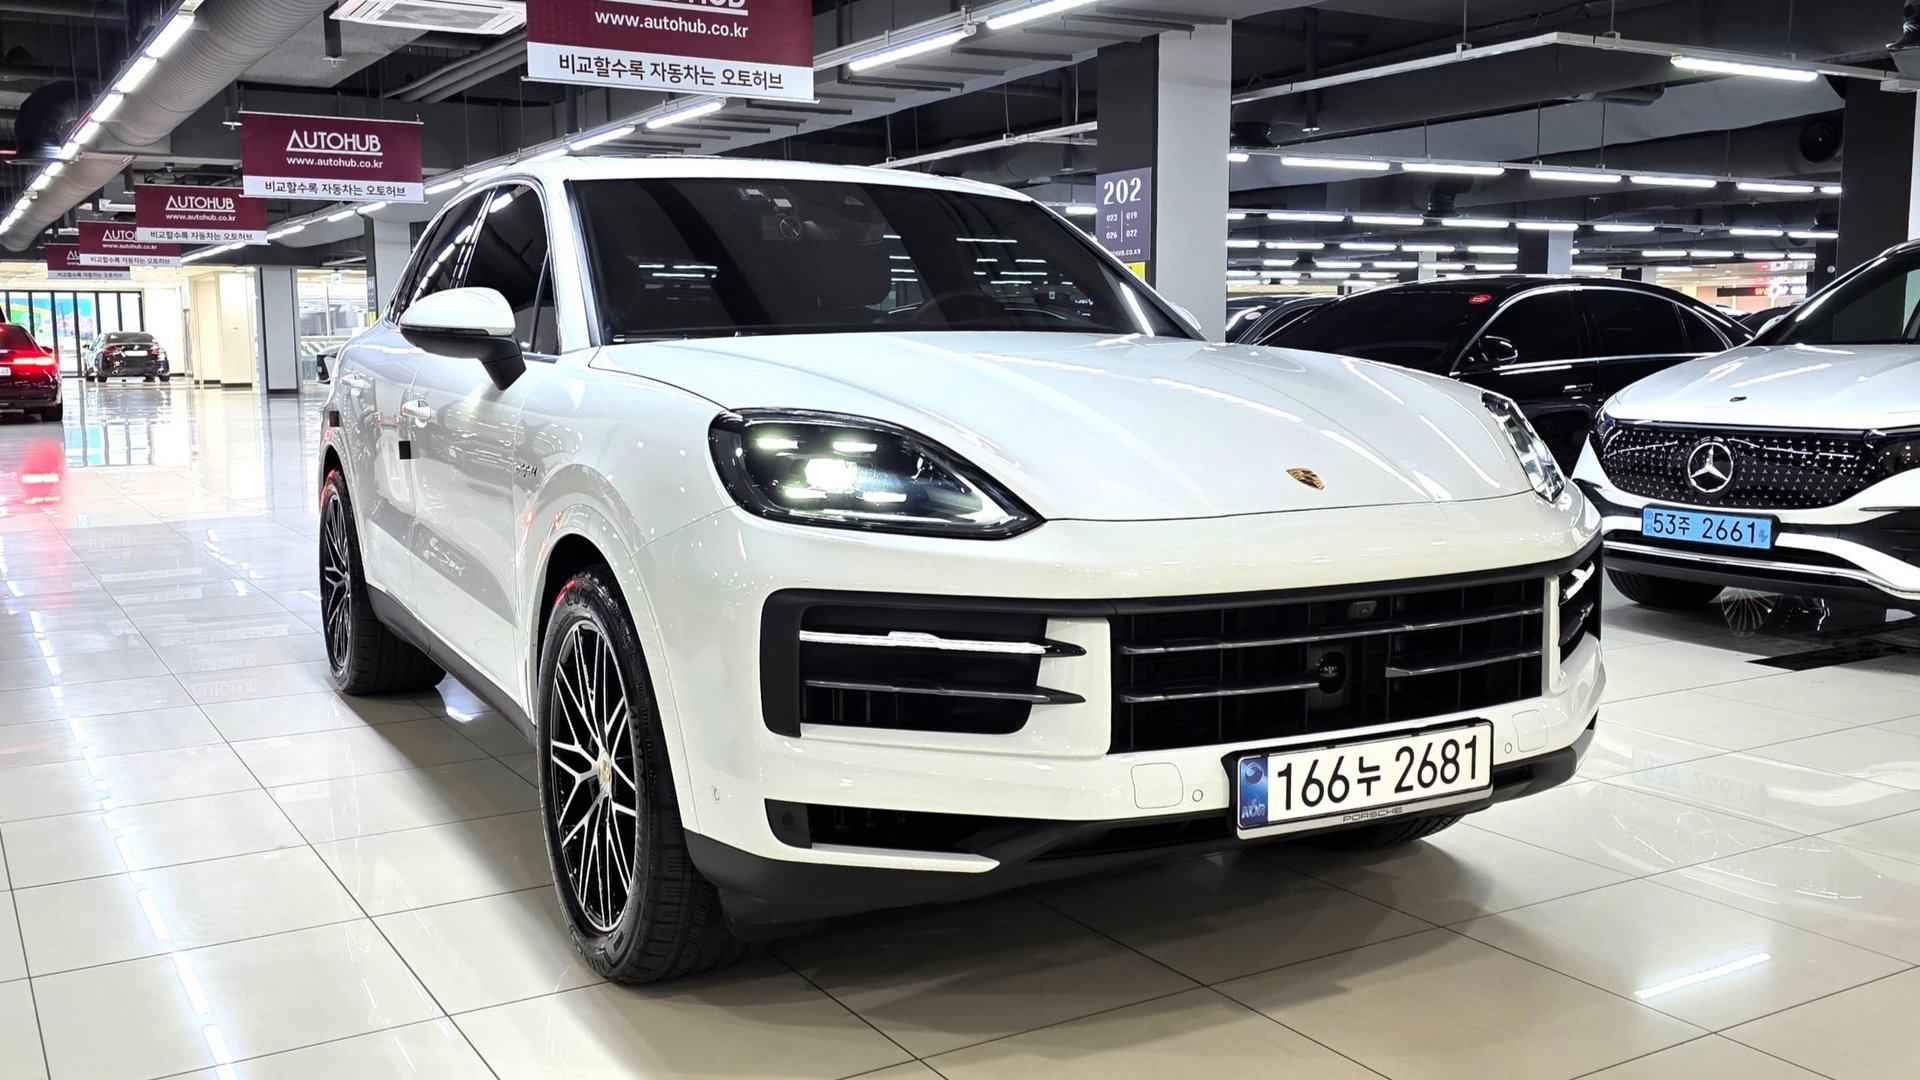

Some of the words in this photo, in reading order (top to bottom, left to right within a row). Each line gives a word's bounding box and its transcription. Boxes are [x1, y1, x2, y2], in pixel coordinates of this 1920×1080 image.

[594, 11, 749, 38] www.autohub.co.kr
[558, 53, 646, 81] 비교할수록
[650, 61, 716, 86] 자동차는
[720, 68, 784, 91] 오토허브
[286, 129, 384, 156] AUTOHUB
[286, 156, 384, 169] www.autohub.co.kr
[264, 181, 319, 194] 비교할수록
[321, 183, 363, 196] 자동차는
[366, 185, 407, 197] 오토허브
[1103, 177, 1142, 206] 202
[165, 195, 236, 213] AUTOHUB
[165, 213, 237, 222] www.autohub.co.kr
[102, 229, 137, 242] AUTO
[150, 231, 189, 241] 비교할수록
[190, 231, 221, 241] 자동차는
[222, 231, 253, 242] 오토허브
[1652, 512, 1691, 536] 53주
[1701, 517, 1756, 544] 2661
[1277, 755, 1381, 811] 166누
[1394, 735, 1478, 794] 2681
[1342, 806, 1403, 823] PORSCHE
